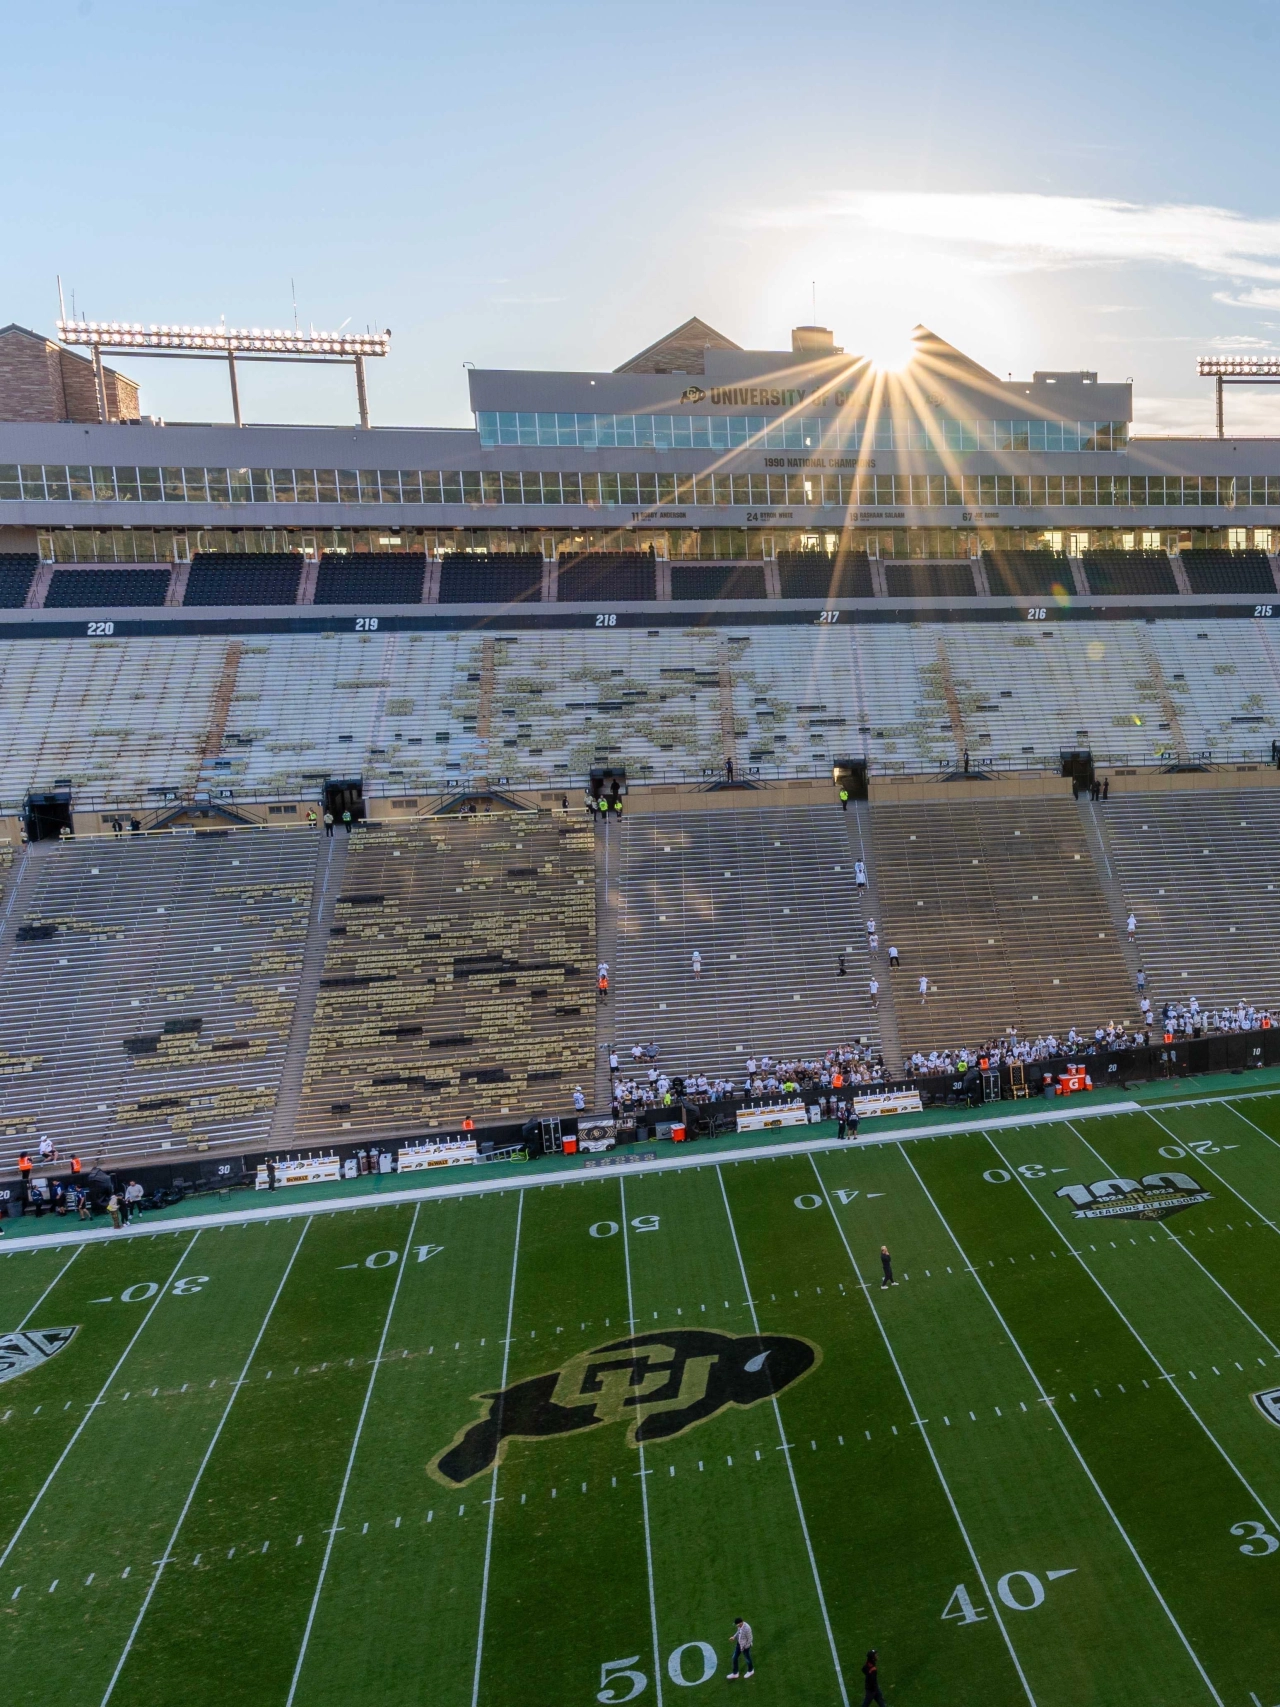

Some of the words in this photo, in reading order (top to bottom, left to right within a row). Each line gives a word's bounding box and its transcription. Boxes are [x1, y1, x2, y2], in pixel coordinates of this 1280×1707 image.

[710, 387, 806, 406] UNIVERSITY
[764, 458, 784, 467] 1990
[787, 458, 826, 468] NATIONAL
[828, 458, 876, 468] CHAMPIONS
[746, 512, 758, 521] 24
[962, 512, 972, 521] 67
[820, 611, 839, 623] 217
[1027, 607, 1046, 621] 216
[1254, 605, 1272, 617] 215
[355, 617, 379, 632] 219
[595, 613, 617, 627] 218
[87, 621, 115, 636] 220
[1108, 1064, 1117, 1072] 20
[953, 1081, 962, 1090] 30
[1069, 1079, 1078, 1088] G
[1158, 1140, 1221, 1159] 20
[218, 1165, 230, 1174] 30
[983, 1164, 1047, 1184] 30
[0, 1190, 10, 1199] 20
[794, 1188, 860, 1209] 40
[1145, 1188, 1174, 1196] 2023
[1091, 1205, 1140, 1217] SEASONS
[1158, 1197, 1198, 1208] FOLSOM
[589, 1215, 661, 1238] 50
[364, 1244, 445, 1269] 40
[120, 1275, 210, 1304] 30
[940, 1569, 1046, 1626] 40
[597, 1641, 718, 1704] 50
